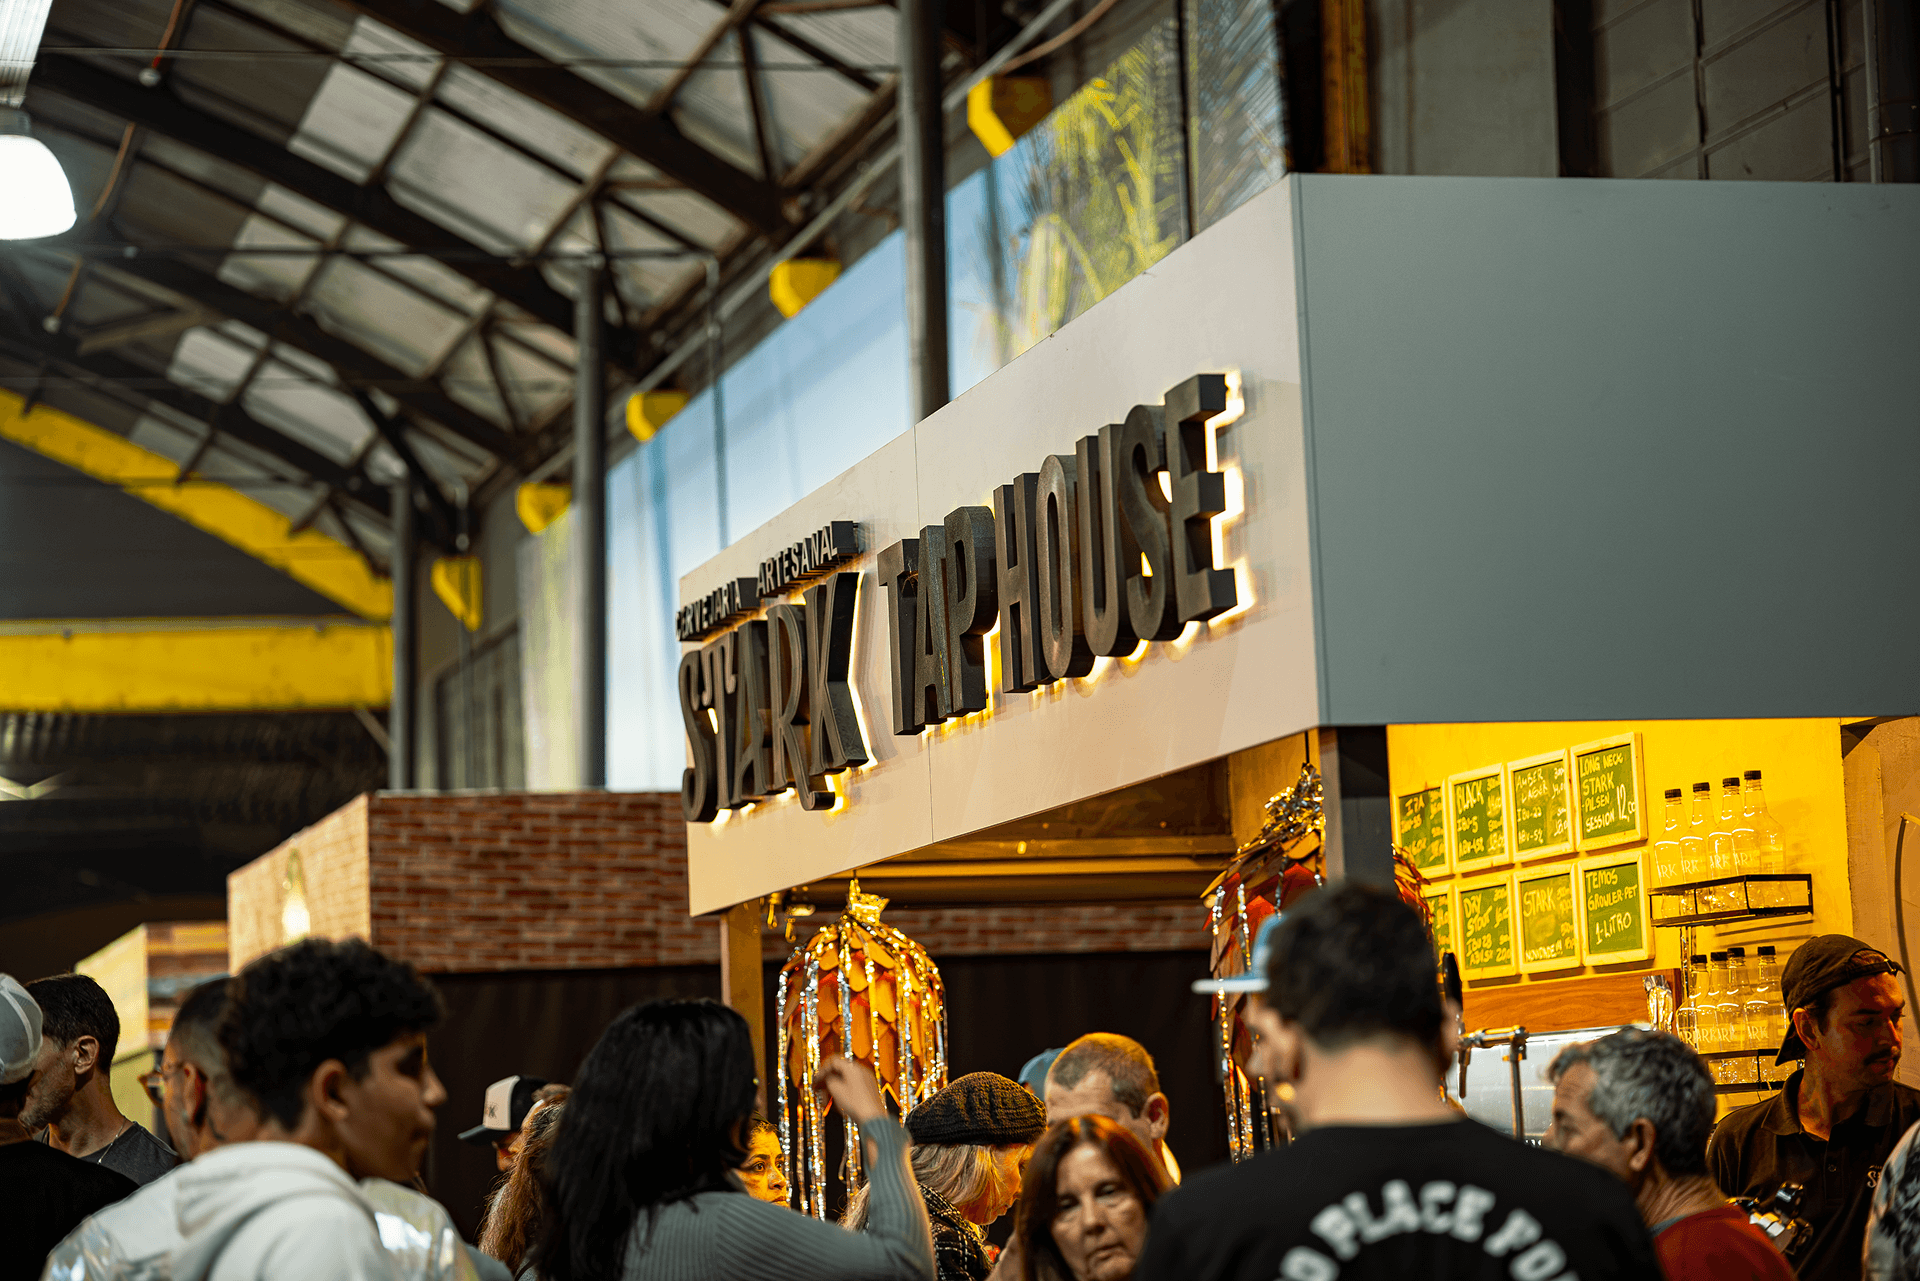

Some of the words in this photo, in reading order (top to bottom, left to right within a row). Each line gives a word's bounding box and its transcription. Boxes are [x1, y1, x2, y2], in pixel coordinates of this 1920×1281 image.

[675, 578, 751, 641] CERVEJARIA
[755, 521, 846, 598] ARTESANAL
[678, 572, 858, 823] STARK
[876, 506, 988, 735] TAP
[993, 374, 1236, 693] HOUSE
[1580, 756, 1601, 778] LONG
[1603, 753, 1624, 769] NECK
[1456, 780, 1484, 814] BLACK
[1582, 771, 1615, 796] STARK
[1586, 808, 1615, 832] SESSION
[1586, 869, 1618, 893] TEMOS
[1523, 887, 1556, 917] STARK
[1466, 905, 1493, 937] STOUT
[1309, 1179, 1497, 1261] PLACE
